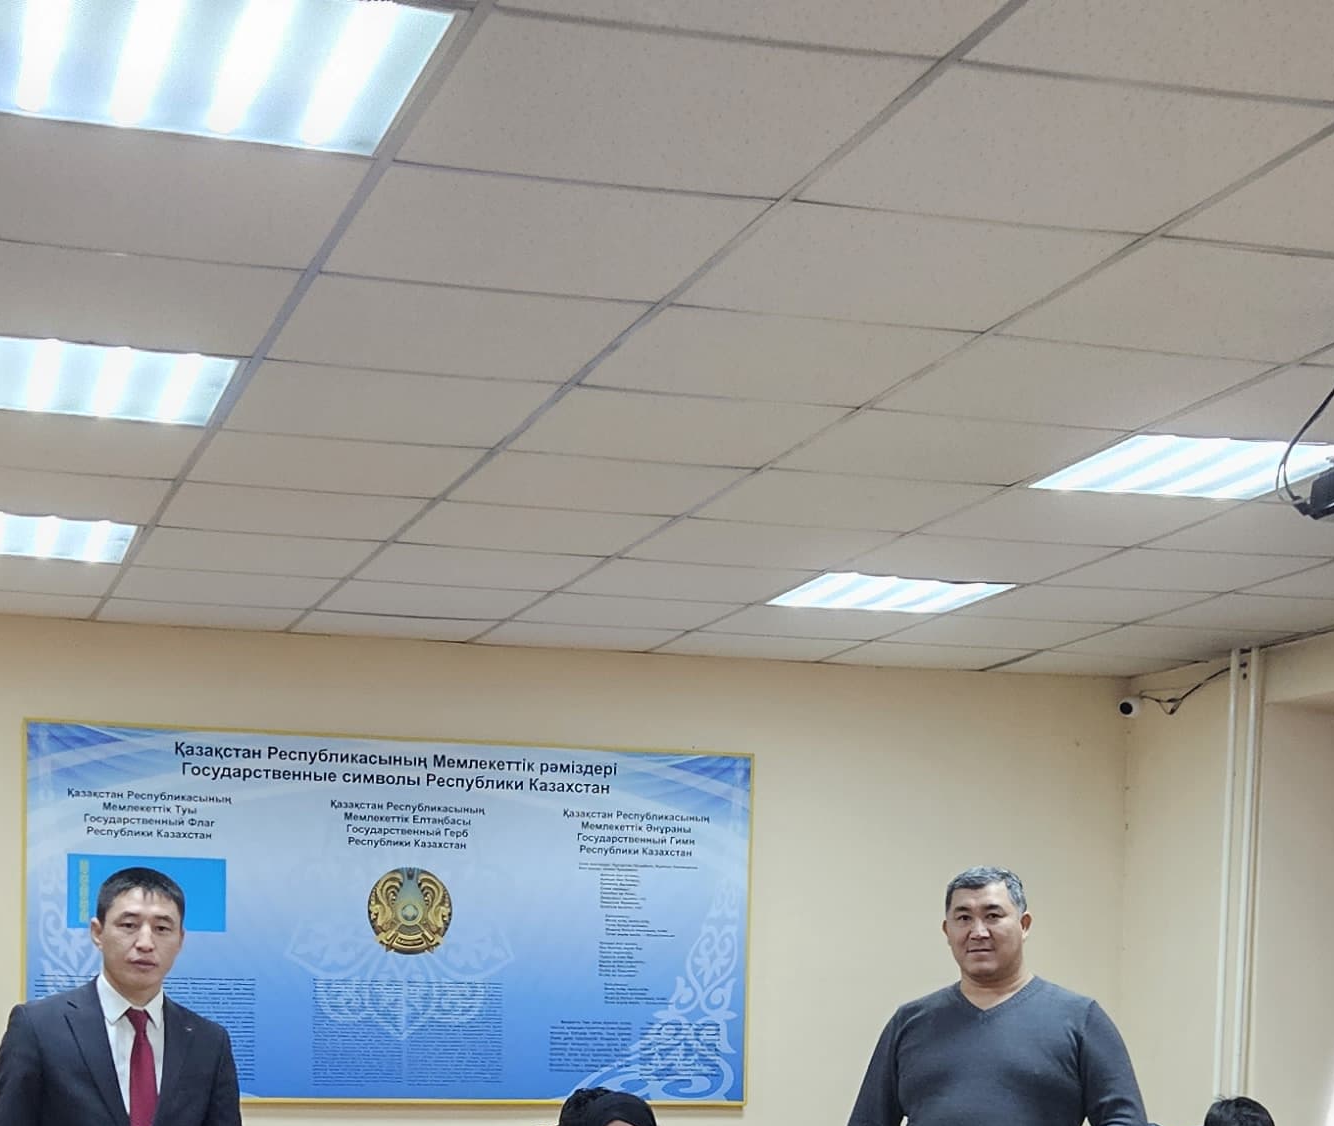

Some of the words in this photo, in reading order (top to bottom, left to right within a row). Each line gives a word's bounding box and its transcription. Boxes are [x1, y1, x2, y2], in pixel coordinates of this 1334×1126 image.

[175, 741, 261, 760] Қазақстан
[267, 746, 427, 768] Республикасының
[433, 754, 534, 772] Мемлекеттік
[540, 760, 617, 778] рәміздері
[182, 762, 337, 782] Государственные
[342, 771, 420, 786] символы
[426, 773, 523, 792] Республики
[529, 778, 610, 794] Казахстан
[67, 788, 123, 799] Қазақстан
[127, 790, 231, 804] Республикасының
[102, 802, 171, 813] Мемлекеттік
[175, 805, 197, 815] Туы
[330, 800, 383, 810] Қазақстан
[386, 802, 485, 815] Республикасының
[83, 813, 184, 826] Государственный
[188, 817, 215, 828] Флаг
[344, 812, 409, 823] Мемлекеттік
[413, 815, 471, 826] Елтаңбасы
[563, 808, 613, 819] Қазақстан
[616, 811, 710, 824] Республикасының
[87, 826, 153, 838] Республики
[156, 829, 212, 840] Казахстан
[346, 824, 441, 836] Государственный
[444, 828, 468, 839] Герб
[581, 822, 643, 832] Мемлекеттік
[646, 824, 691, 834] Әнұраны
[348, 837, 411, 848] Республики
[414, 839, 467, 849] Казахстан
[577, 833, 667, 845] Государственный
[670, 837, 695, 845] Гимн
[580, 845, 639, 856] Республики
[642, 847, 692, 857] Казахстан
